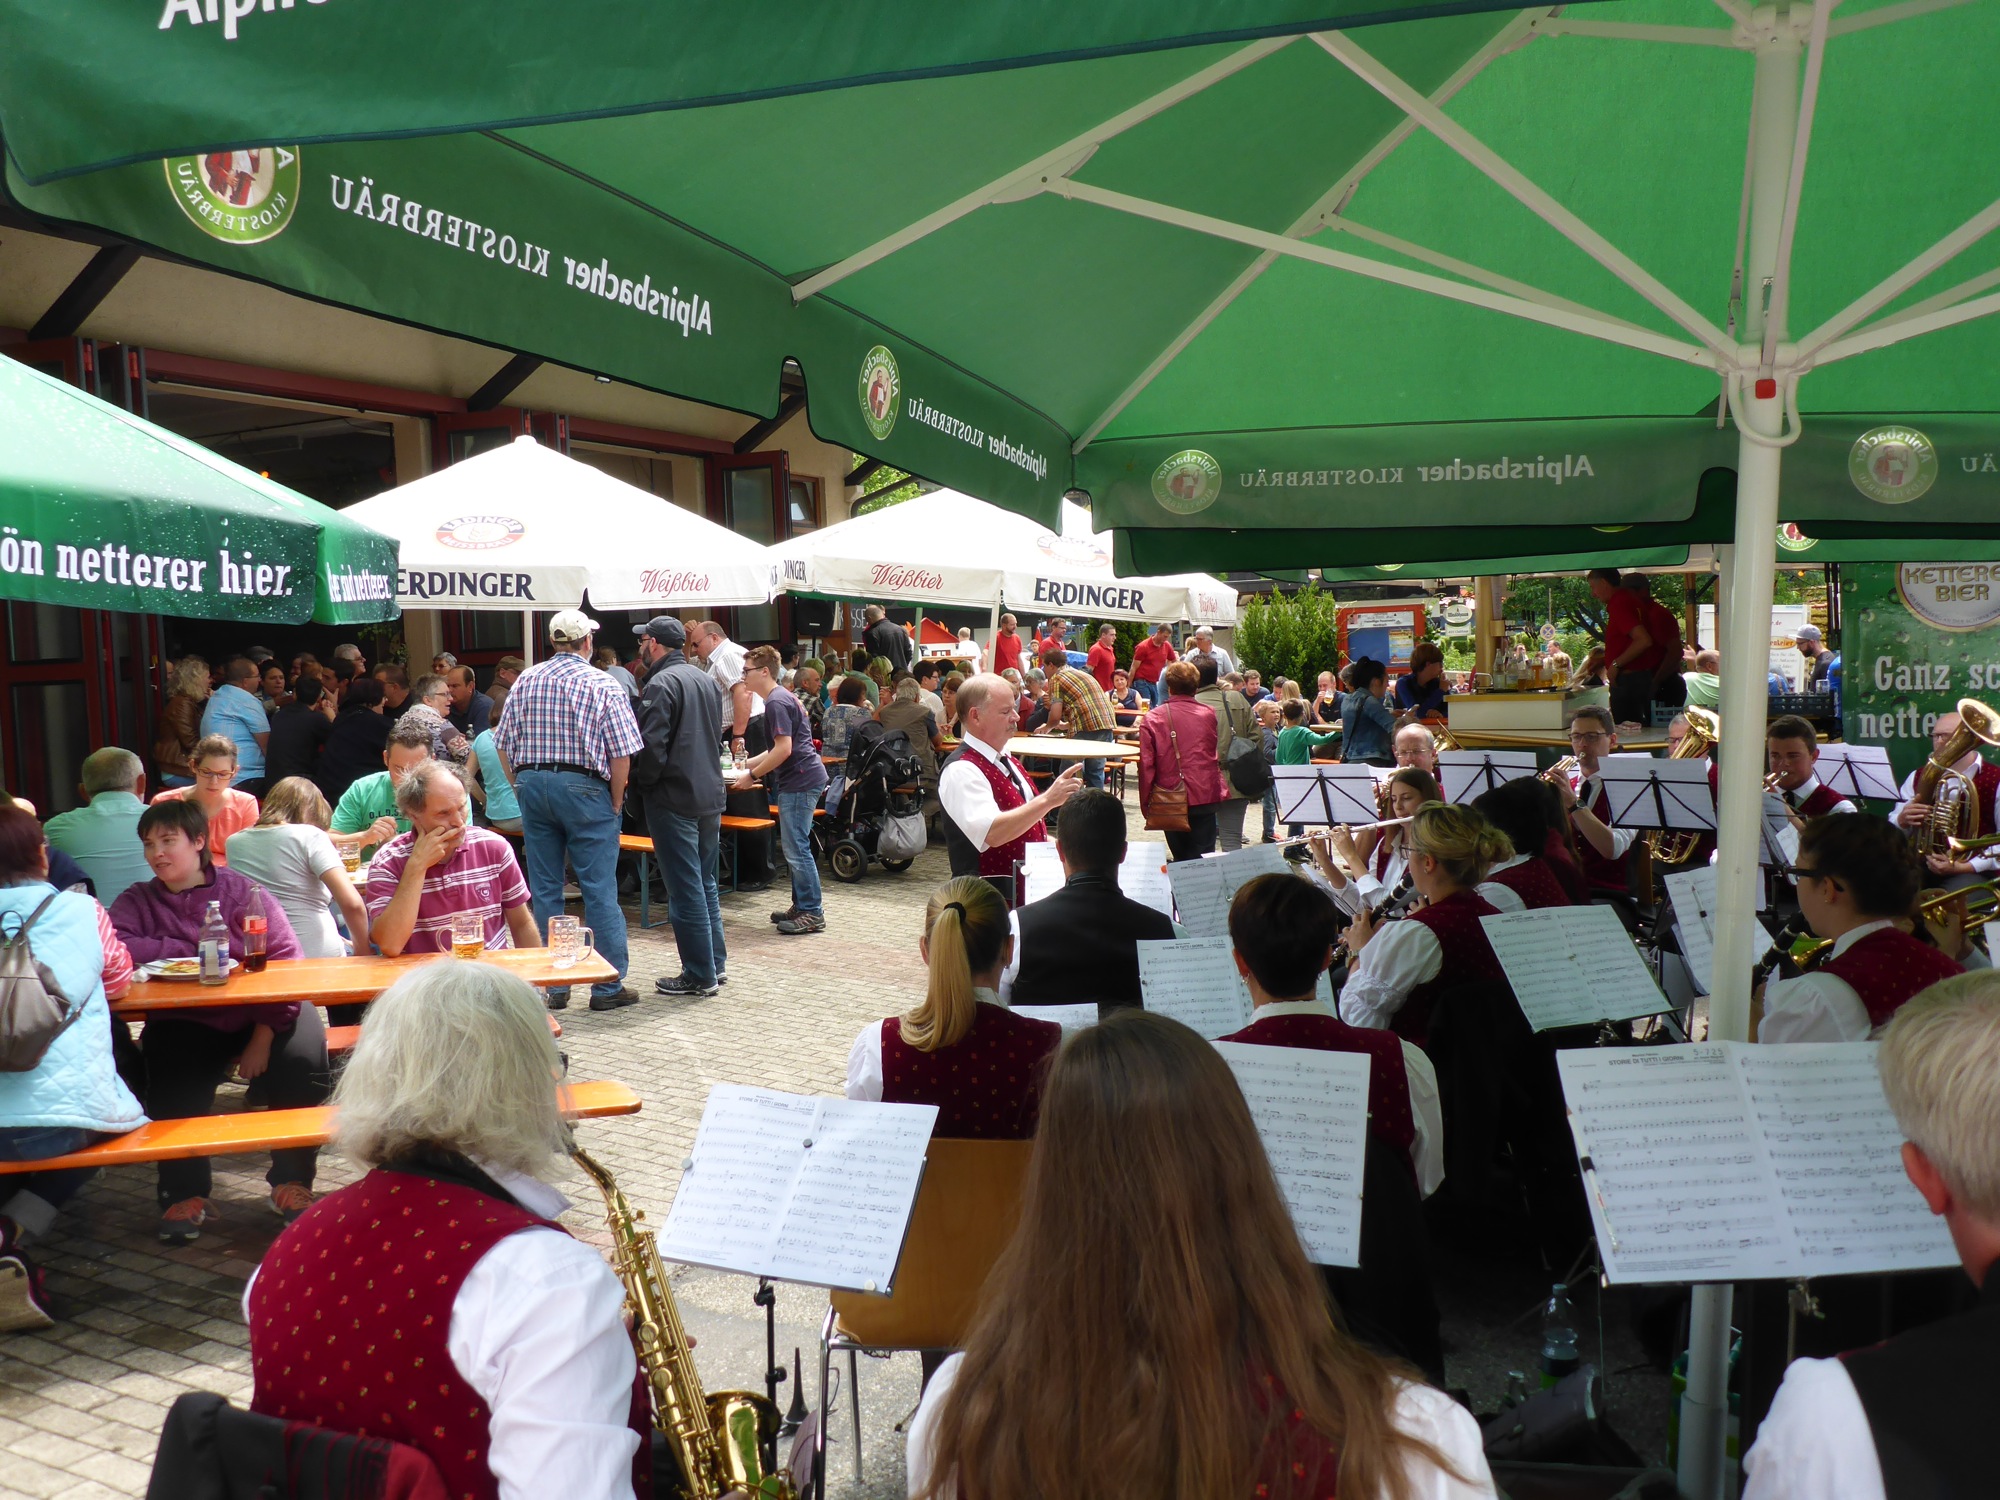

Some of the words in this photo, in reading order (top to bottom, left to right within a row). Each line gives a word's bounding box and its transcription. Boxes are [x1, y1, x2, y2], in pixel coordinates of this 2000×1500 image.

[442, 516, 523, 532] ERDINGER
[56, 543, 207, 593] netterer
[220, 550, 293, 596] hier.
[396, 568, 536, 601] ERDINGER
[640, 568, 711, 598] Weißbier
[871, 563, 945, 591] Weißbier
[1034, 577, 1145, 614] ERDINGER
[1935, 584, 1990, 603] BIER
[1875, 655, 1951, 692] Ganz
[1859, 705, 1946, 739] nette
[1608, 1058, 1632, 1066] STORIE
